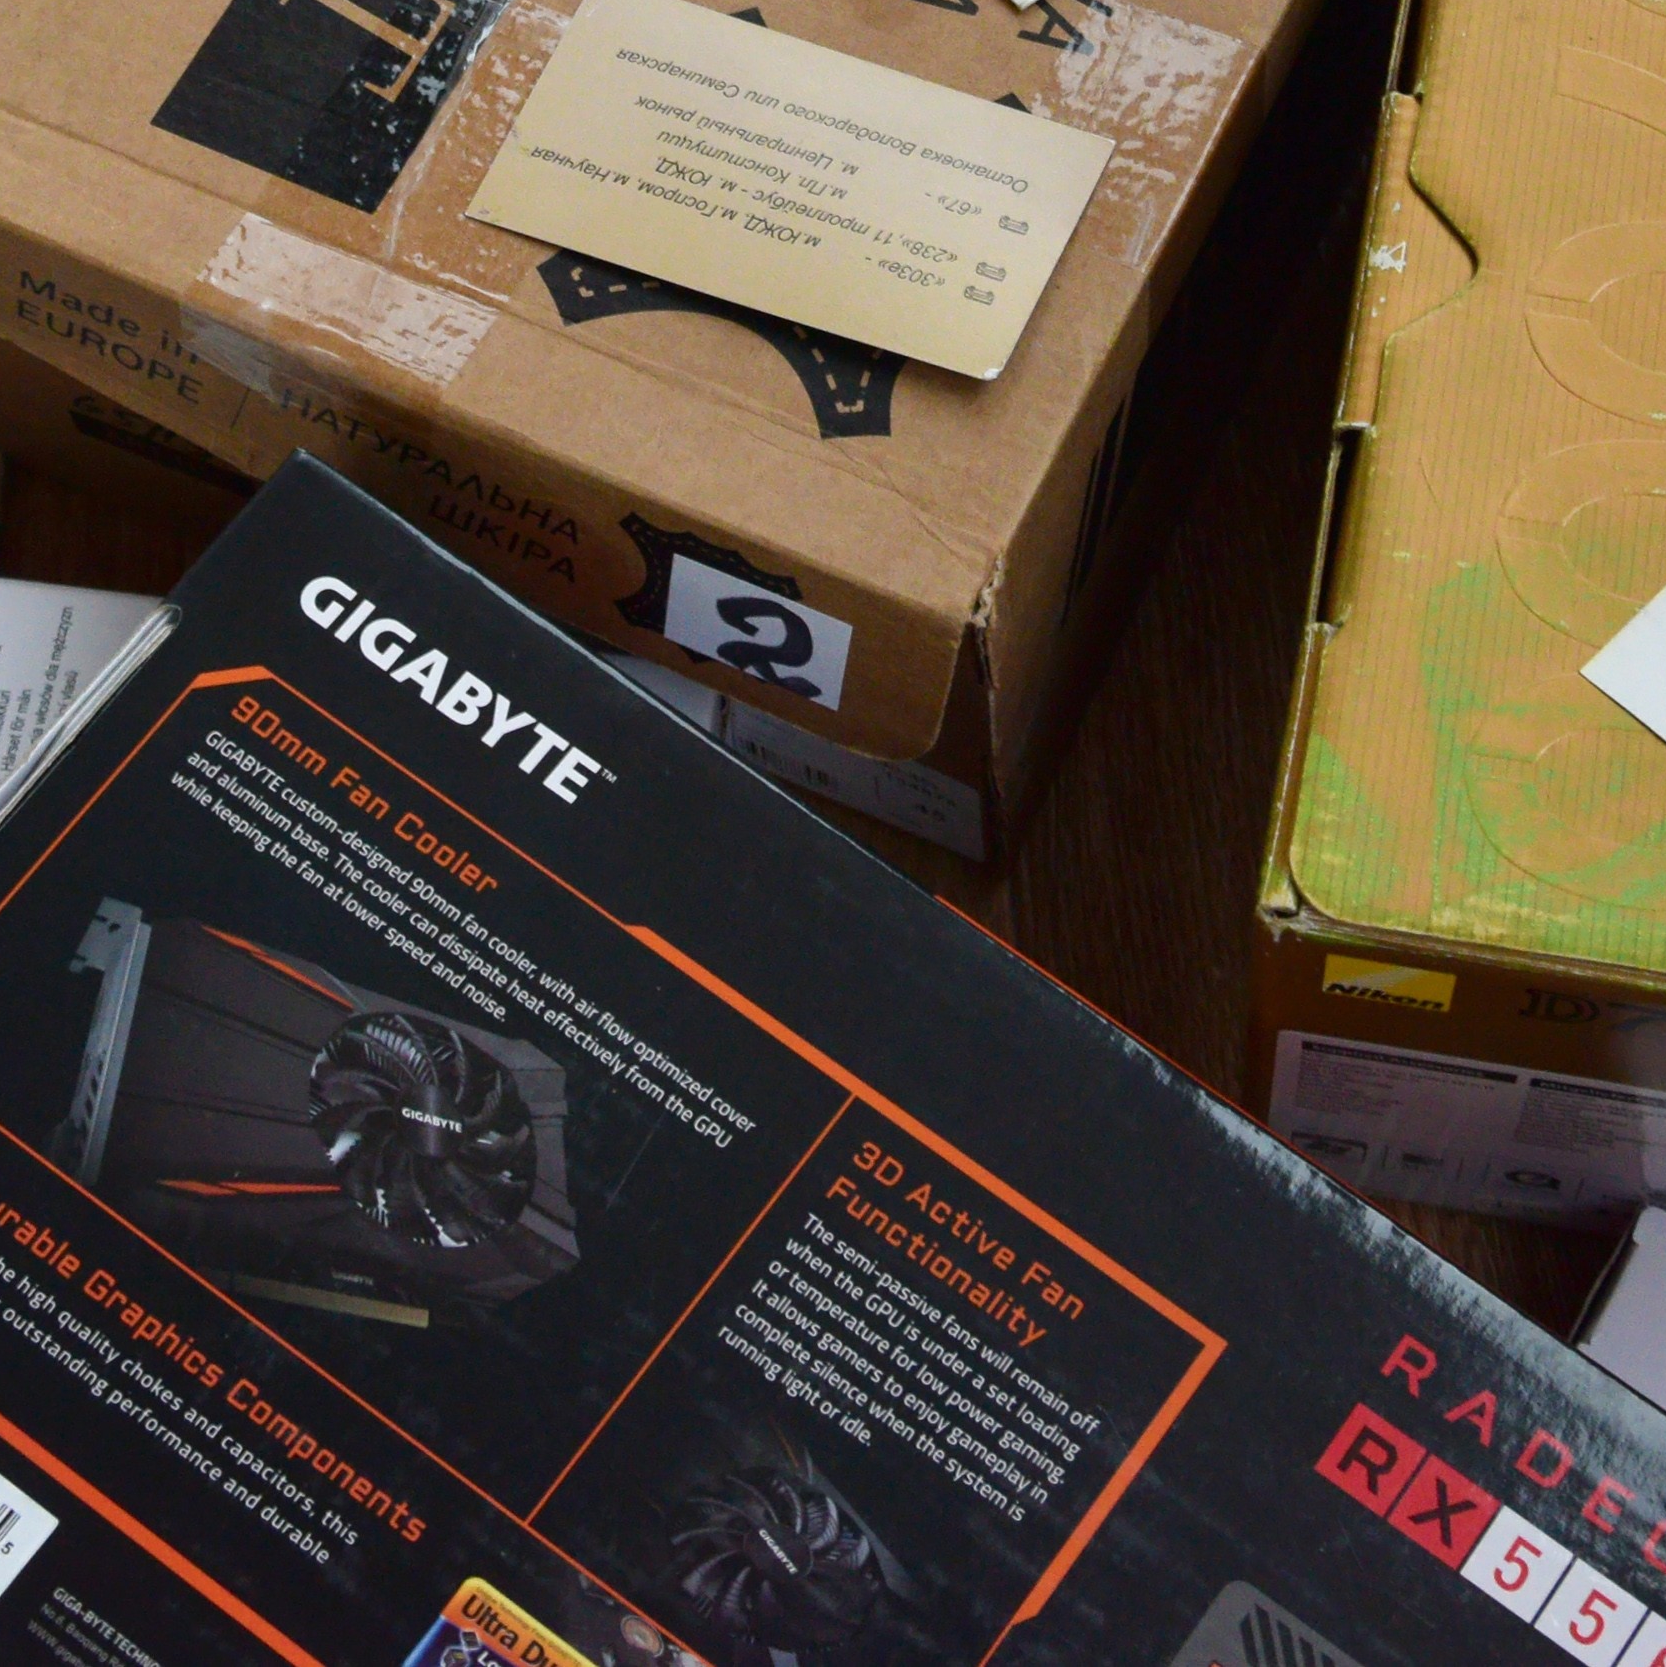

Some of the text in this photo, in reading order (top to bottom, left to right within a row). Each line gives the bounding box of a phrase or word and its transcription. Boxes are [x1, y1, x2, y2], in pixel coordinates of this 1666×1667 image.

[529, 145, 631, 186] м.Научная
[633, 94, 698, 123] рынок
[695, 115, 834, 170] Центральный
[14, 297, 207, 408] EUROPE
[20, 269, 117, 341] Made
[280, 387, 583, 548] НАТУРАЛЬНА
[297, 575, 606, 805] GIGABYTE
[230, 694, 498, 892] 90mm Fan Cooler
[825, 1174, 1047, 1346] Functionality
[852, 1140, 1084, 1320] 3D Active Fan
[82, 1268, 224, 1388] Graphics
[225, 1377, 427, 1542] Components
[1337, 1423, 1478, 1550] RX
